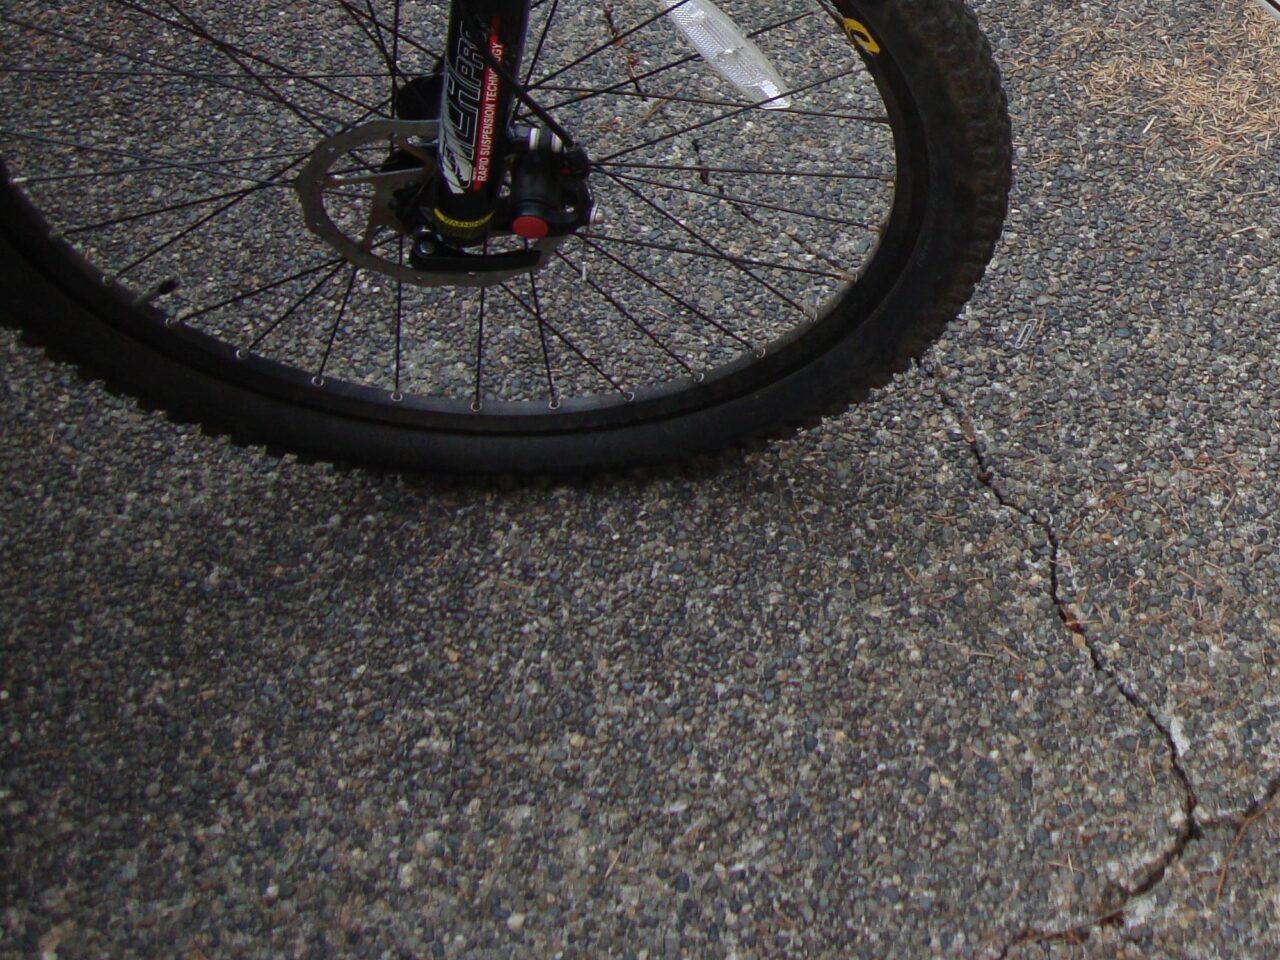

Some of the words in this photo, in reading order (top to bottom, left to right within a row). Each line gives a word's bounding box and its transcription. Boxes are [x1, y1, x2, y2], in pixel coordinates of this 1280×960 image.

[485, 42, 503, 104] TECHNOGY
[480, 105, 496, 155] SUSPENSION
[477, 156, 490, 183] RAPID
